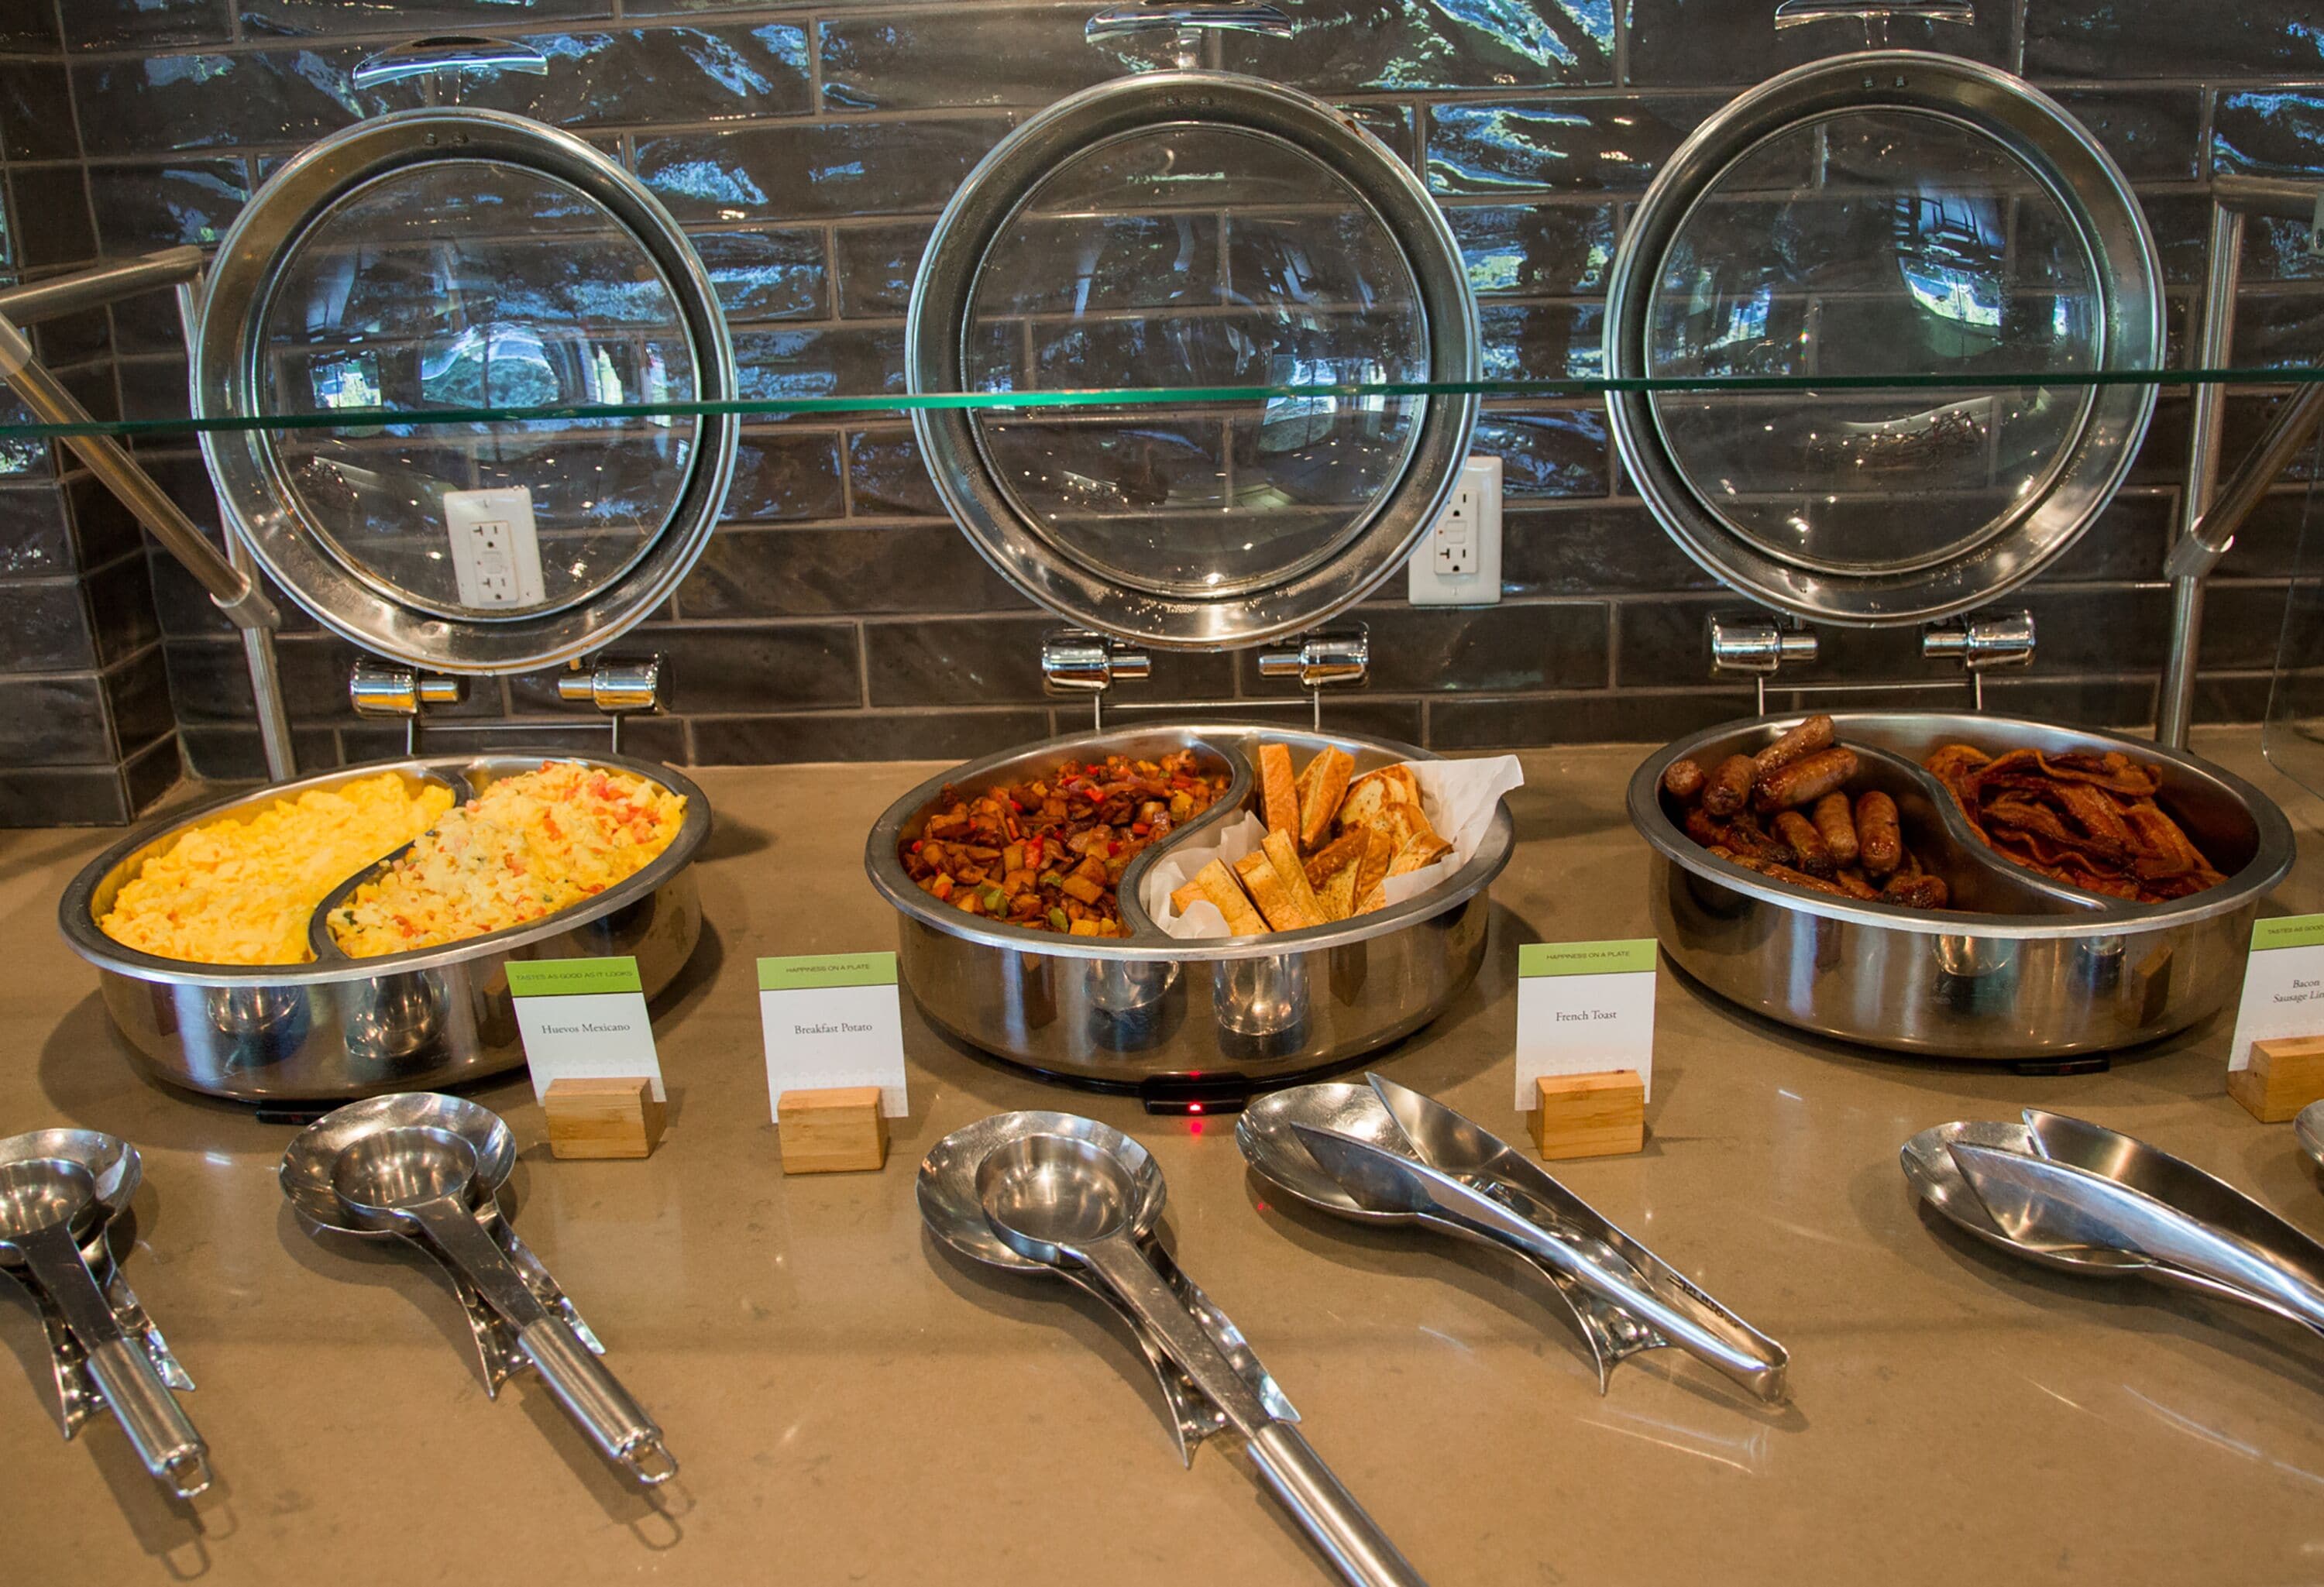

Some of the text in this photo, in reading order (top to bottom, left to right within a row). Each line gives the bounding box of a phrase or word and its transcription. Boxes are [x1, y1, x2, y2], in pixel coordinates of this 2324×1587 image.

[2293, 979, 2320, 988] Bacon
[2273, 994, 2308, 1004] Sausage
[1556, 1009, 1618, 1022] French Toast
[541, 1022, 631, 1035] Huevos Mexicano
[794, 1022, 873, 1035] Breakfast Potato
